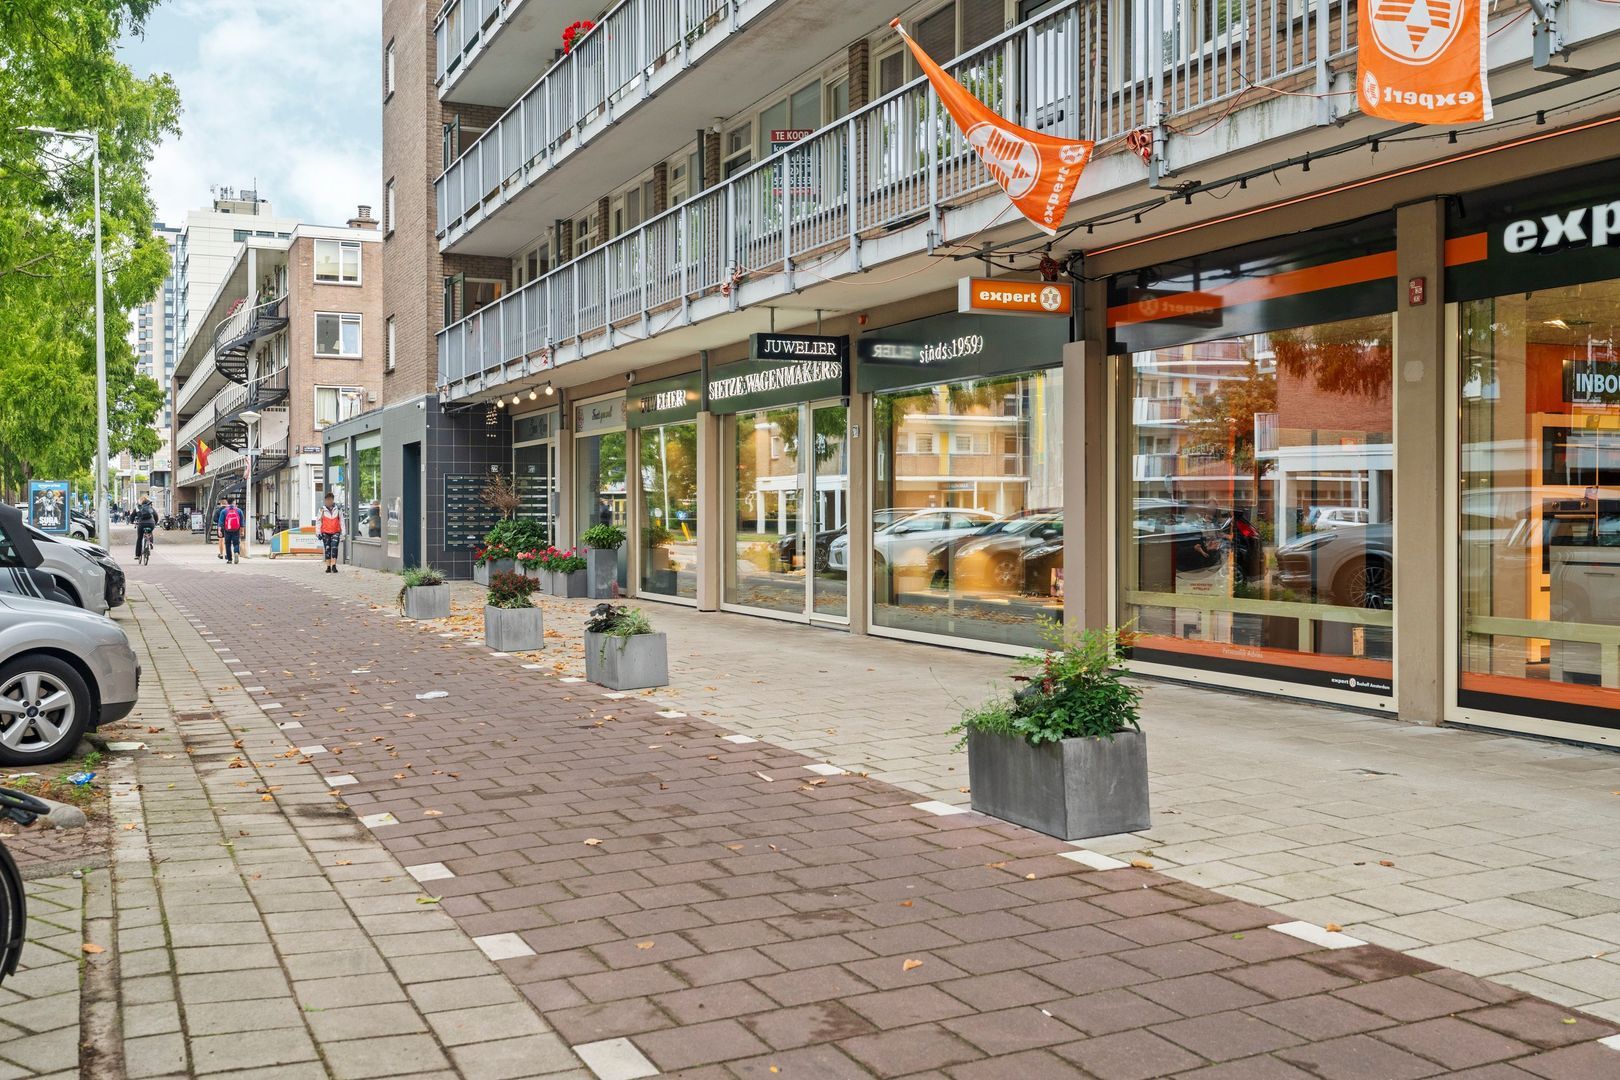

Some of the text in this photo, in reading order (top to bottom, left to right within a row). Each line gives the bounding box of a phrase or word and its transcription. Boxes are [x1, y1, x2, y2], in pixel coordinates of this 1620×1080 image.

[775, 131, 785, 141] TE
[1043, 166, 1071, 225] expert
[979, 289, 1037, 304] expert
[764, 339, 837, 356] JUWELIER
[919, 334, 983, 364] sinds 1959
[708, 361, 841, 400] SIETZE WAGENMAKERS
